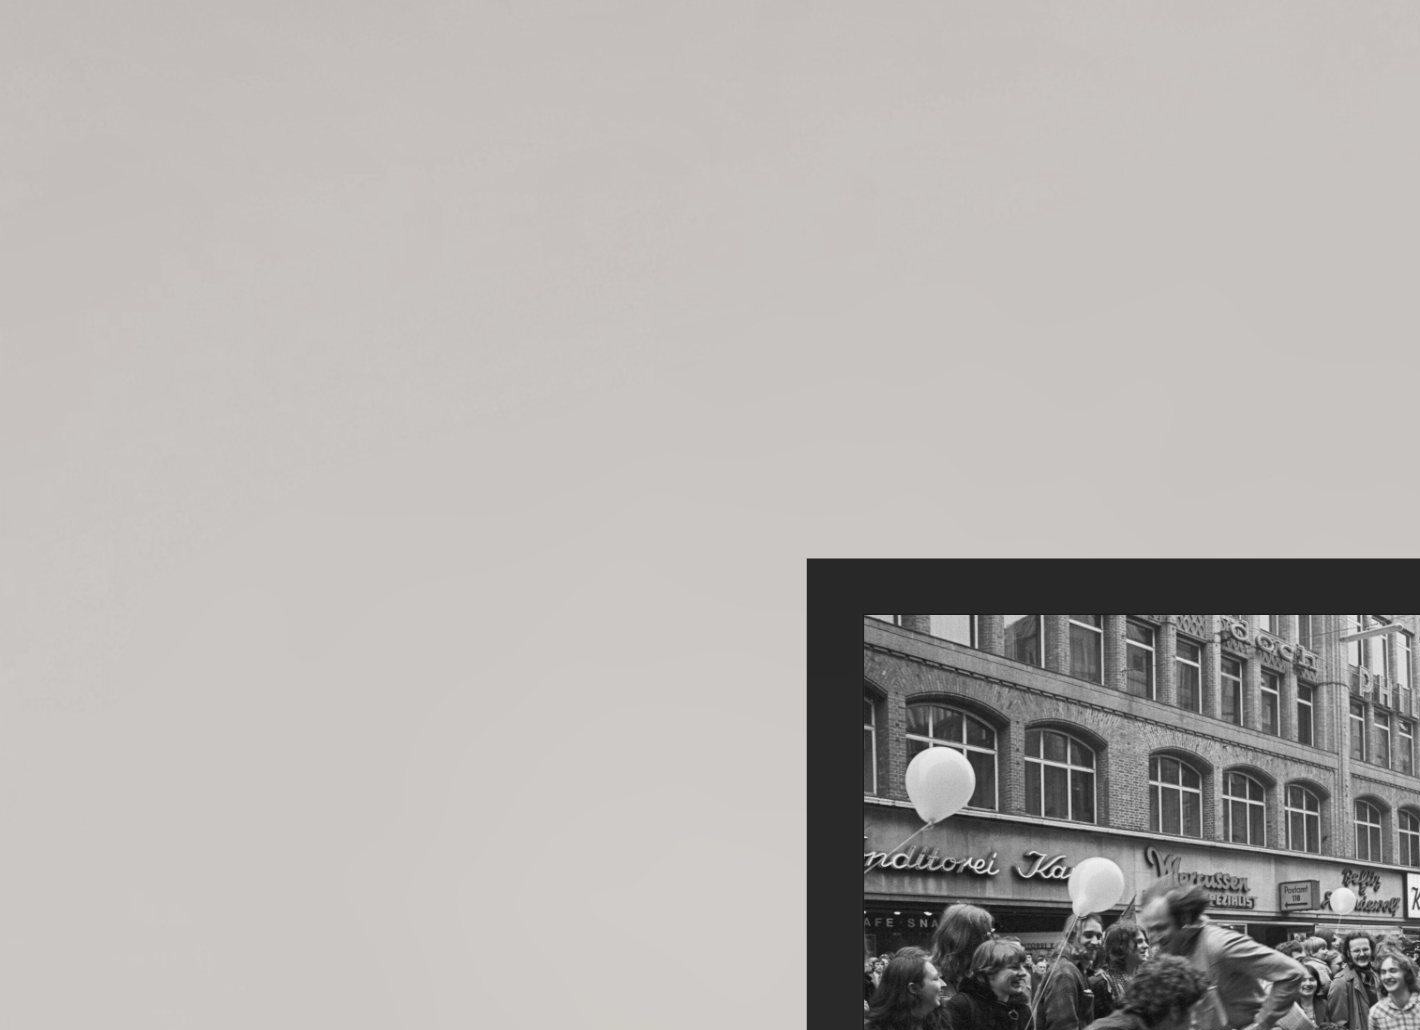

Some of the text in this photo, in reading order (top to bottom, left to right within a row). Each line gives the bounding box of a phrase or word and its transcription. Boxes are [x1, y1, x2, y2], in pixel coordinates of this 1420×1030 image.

[1014, 850, 1073, 880] Ka
[1284, 885, 1309, 895] Postamt
[907, 918, 940, 929] SNA
